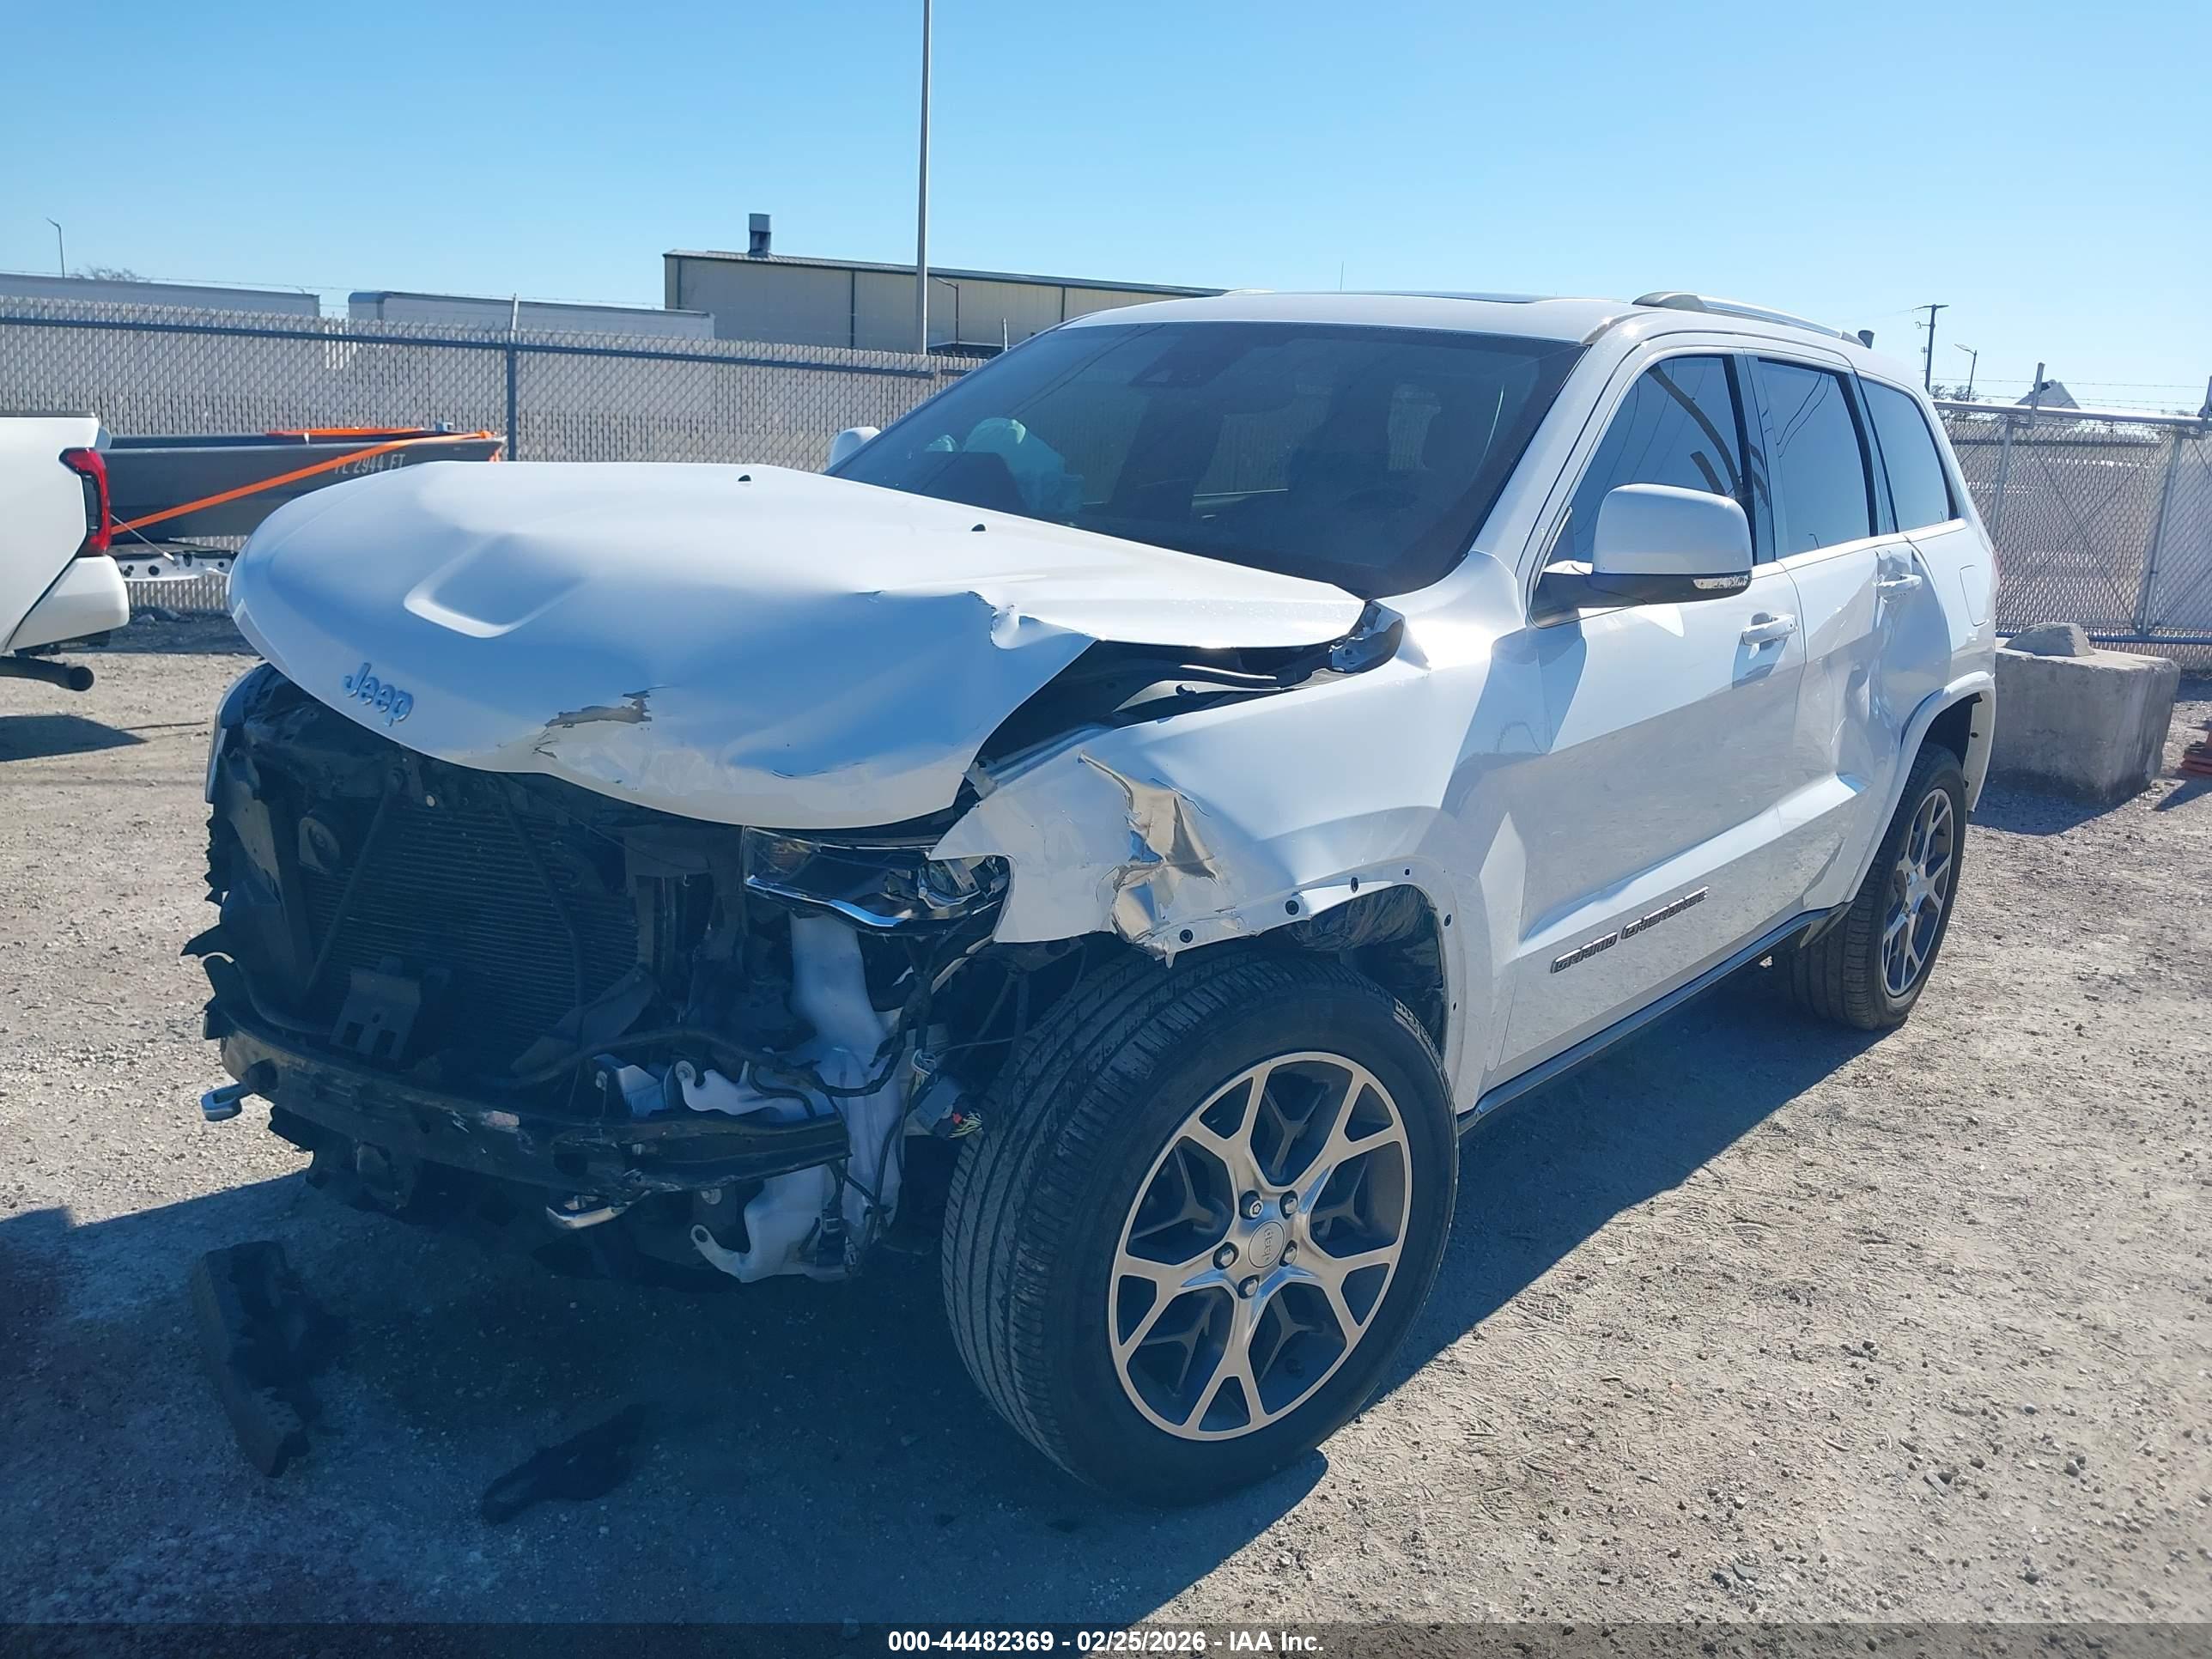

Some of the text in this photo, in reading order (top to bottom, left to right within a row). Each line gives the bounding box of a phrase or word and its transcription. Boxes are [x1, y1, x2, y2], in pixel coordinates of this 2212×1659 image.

[353, 454, 386, 474] 2944
[389, 453, 406, 470] FT
[343, 662, 414, 727] Jeep
[1550, 885, 1710, 974] GRAND CHEROKEE
[1262, 1228, 1274, 1262] Jeep
